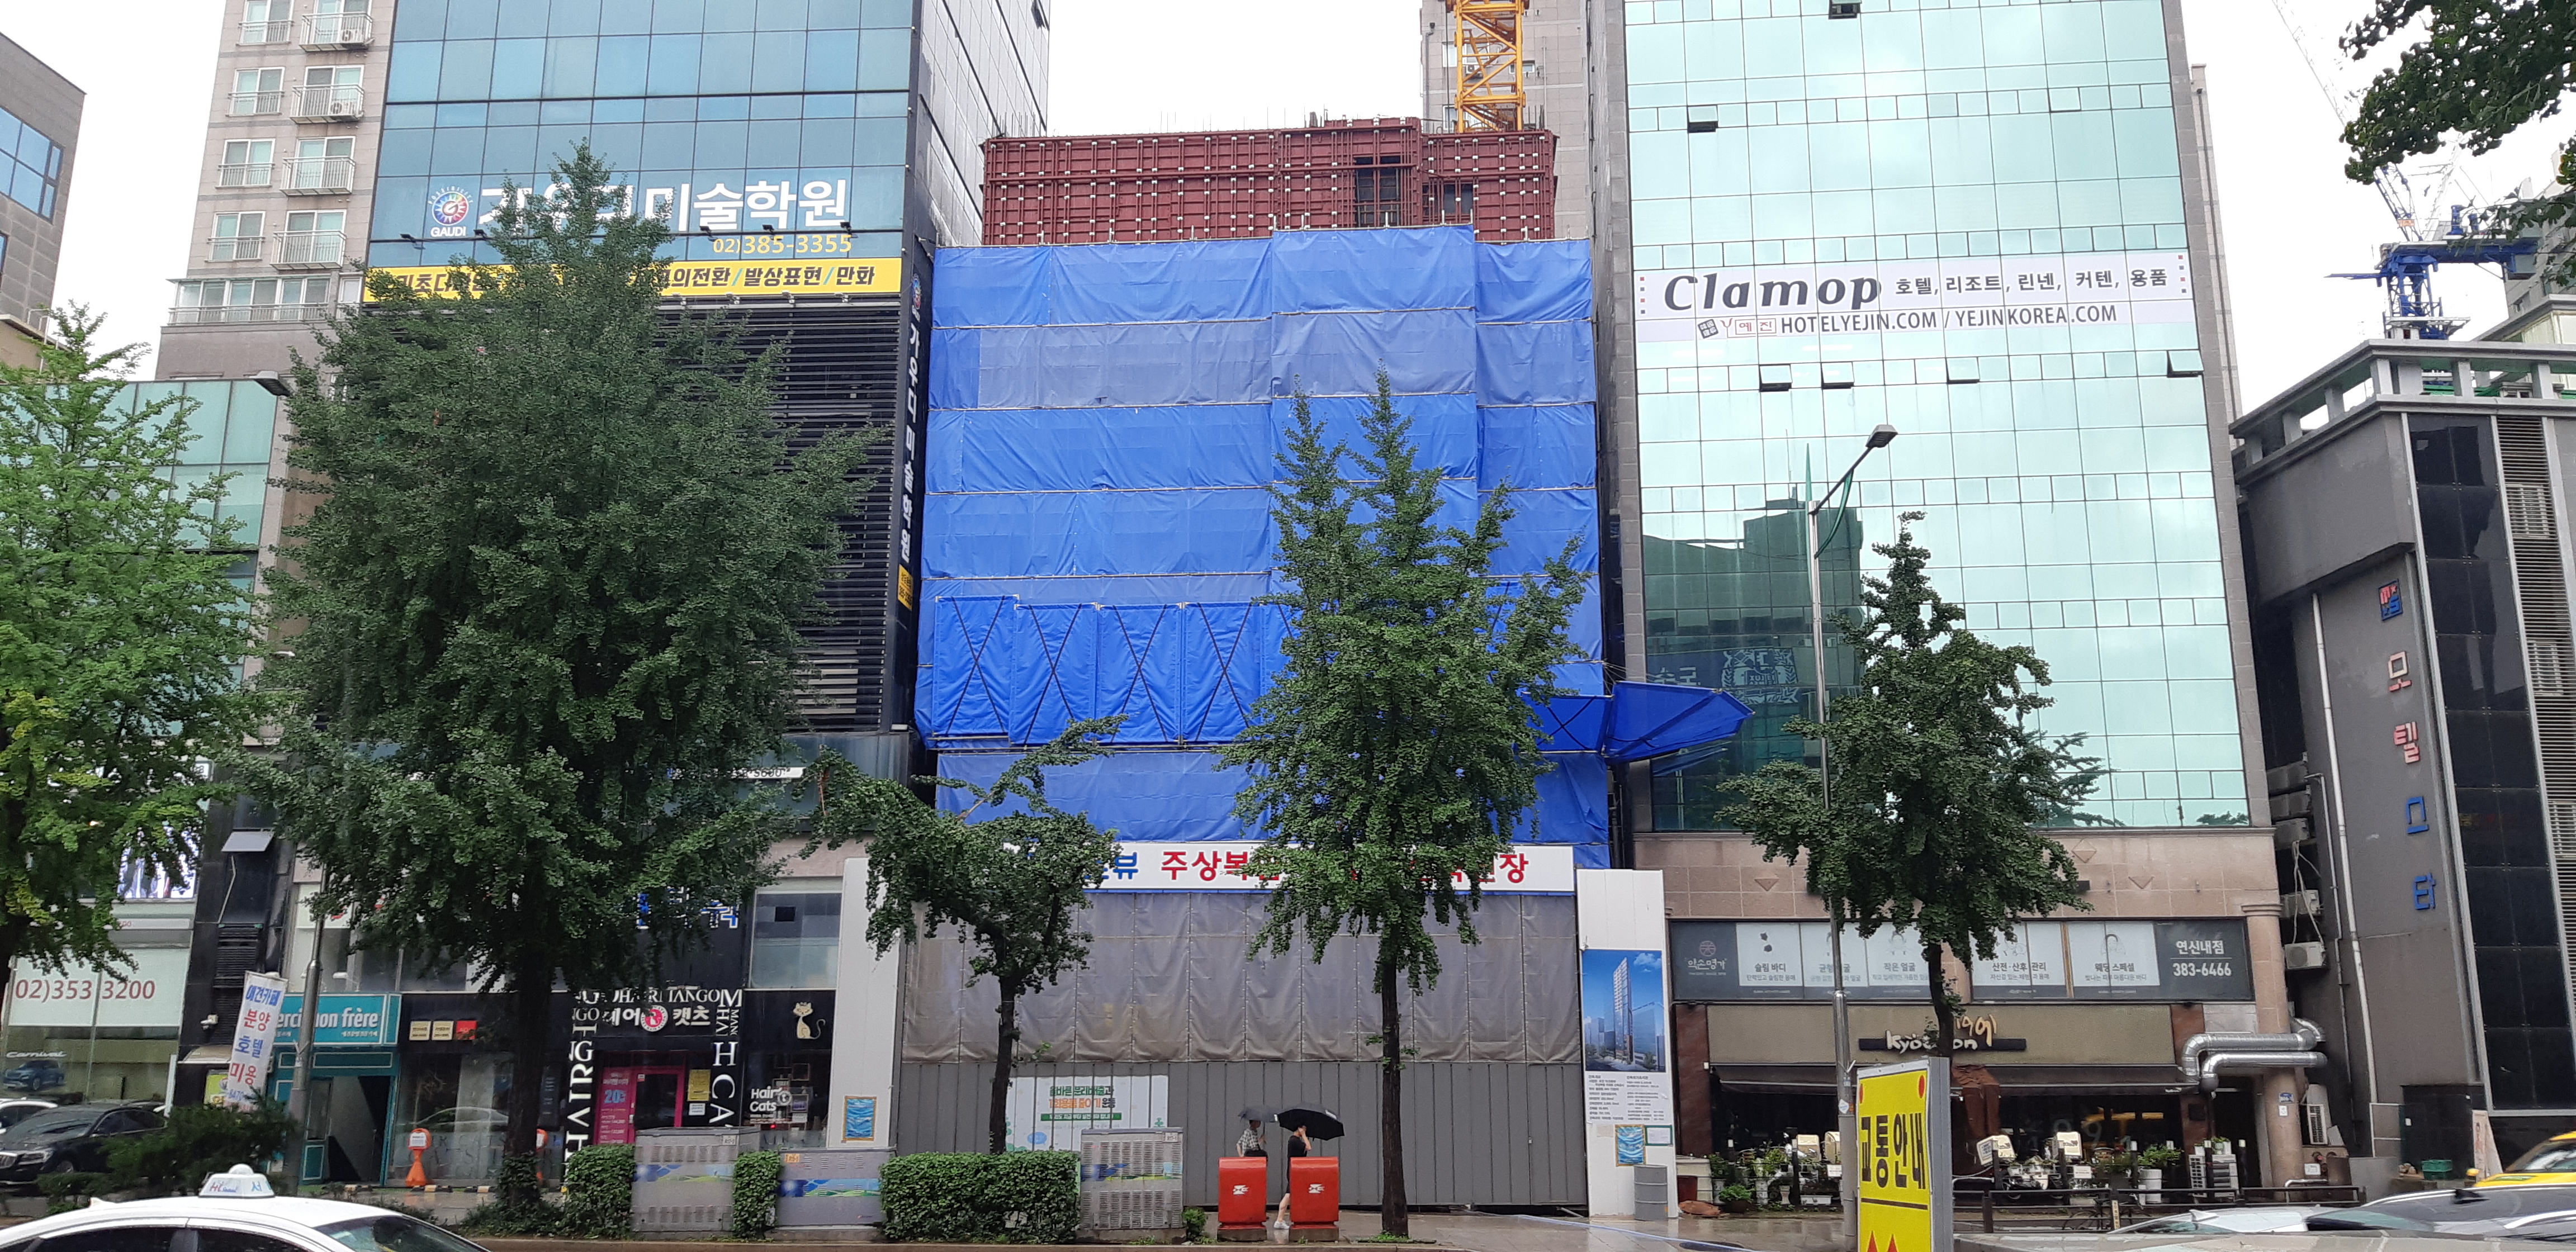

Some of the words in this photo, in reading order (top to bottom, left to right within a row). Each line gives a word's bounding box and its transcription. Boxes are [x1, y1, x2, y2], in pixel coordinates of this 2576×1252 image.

[430, 226, 466, 237] GAUDI
[713, 234, 852, 254] 02)385-3355
[745, 266, 821, 286] 발상표현
[836, 265, 875, 286] 만화
[2130, 269, 2167, 287] 용품
[1664, 273, 1882, 310] Clamop
[1781, 311, 1936, 334] HOTELYEJIN.COM
[2176, 940, 2224, 955] 연신내점
[1755, 963, 1769, 973] 슬림
[1771, 963, 1786, 973] 바디
[1884, 962, 1899, 972] 작은
[1901, 962, 1916, 972] 얼굴
[2032, 962, 2047, 972] 관리
[2172, 962, 2232, 977] 383-6466
[244, 1009, 271, 1031] 분양
[277, 1008, 302, 1027] erci
[315, 1013, 338, 1027] on
[342, 1007, 378, 1027] frère
[673, 1006, 711, 1026] 캣츠
[230, 1063, 257, 1085] 미용
[751, 1086, 782, 1099] Hair
[750, 1101, 776, 1112] Cats
[1861, 1113, 1926, 1189] 교통안내
